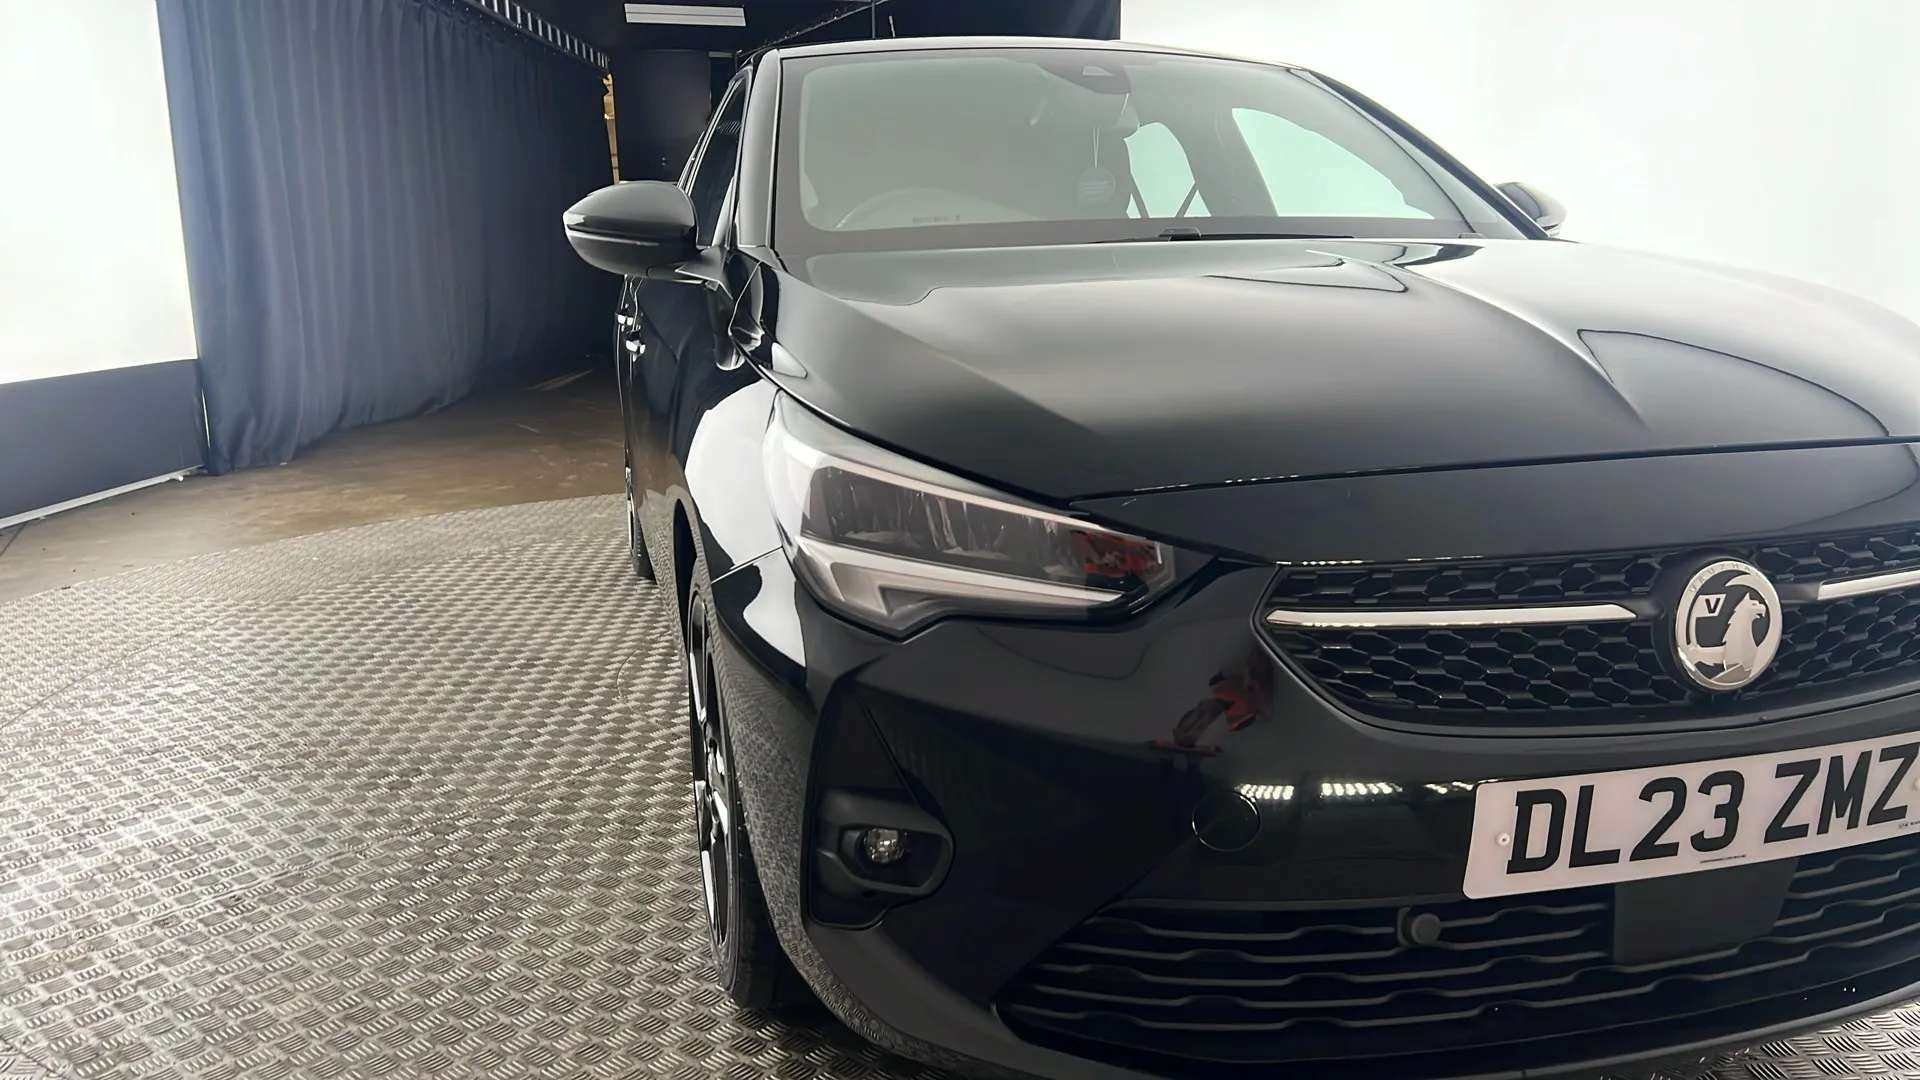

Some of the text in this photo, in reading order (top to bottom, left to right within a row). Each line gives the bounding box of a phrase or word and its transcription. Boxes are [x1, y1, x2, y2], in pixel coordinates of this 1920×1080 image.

[1705, 597, 1721, 614] V
[1506, 742, 1920, 875] DL23 ZMZ
